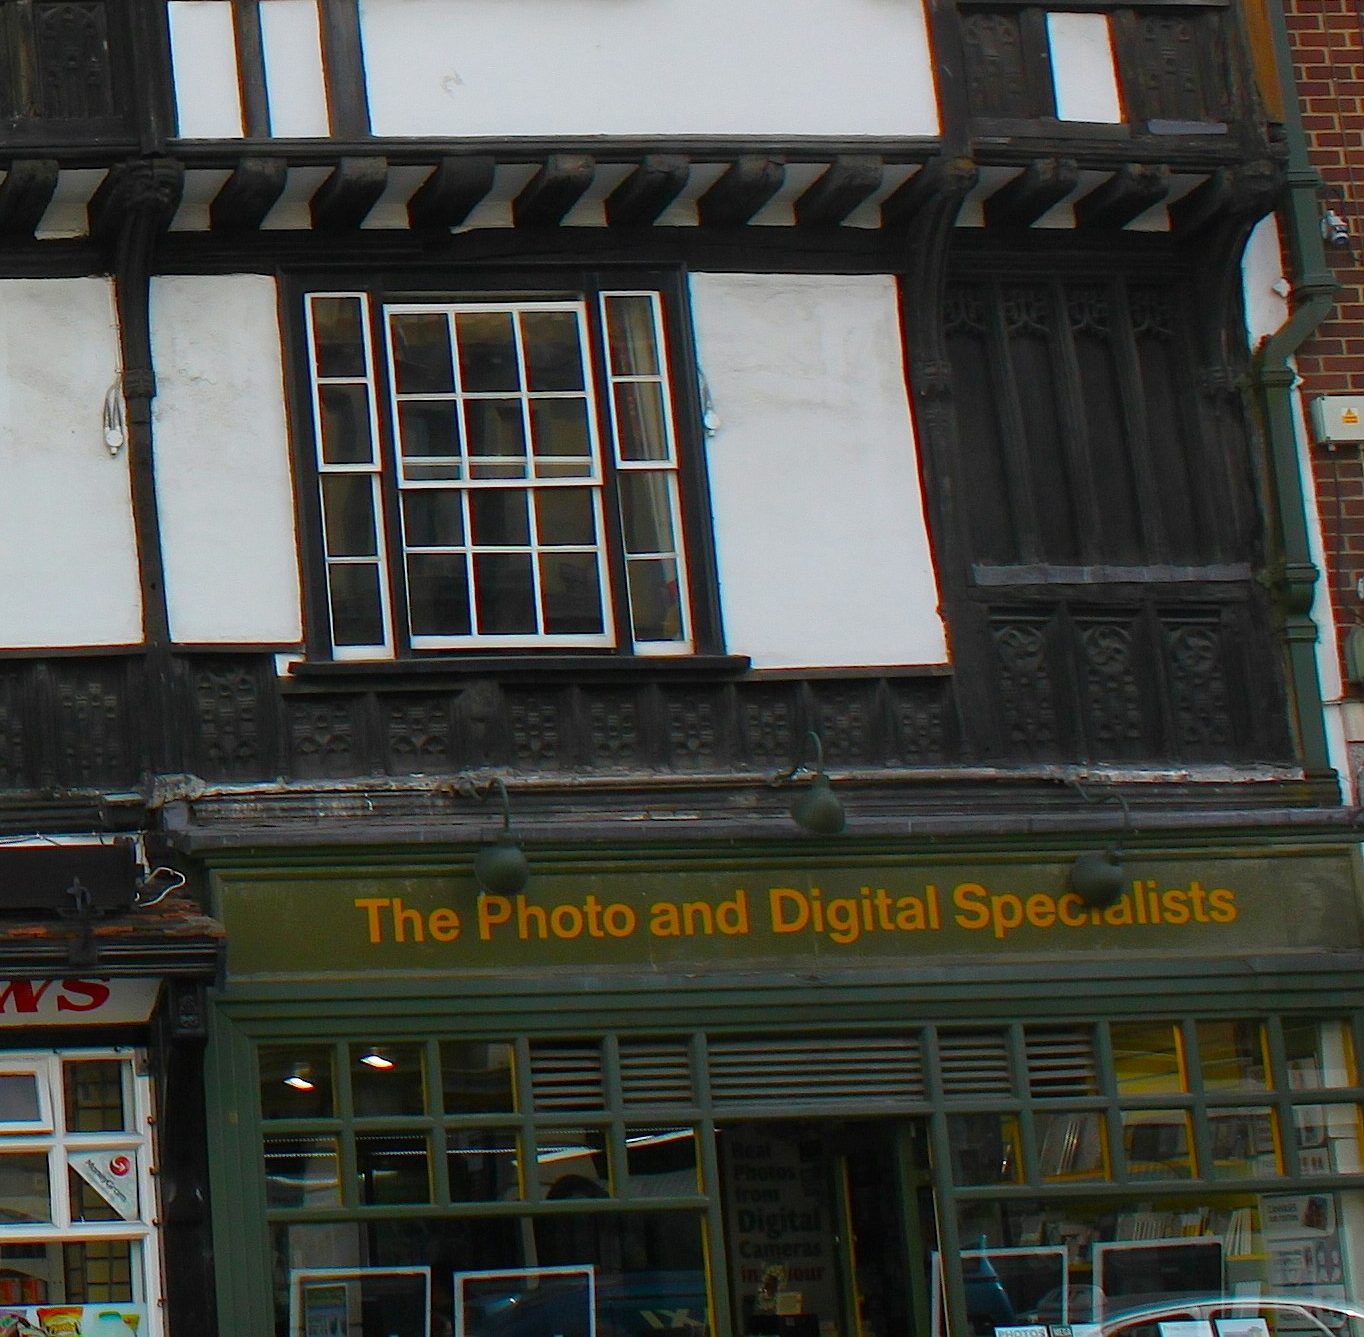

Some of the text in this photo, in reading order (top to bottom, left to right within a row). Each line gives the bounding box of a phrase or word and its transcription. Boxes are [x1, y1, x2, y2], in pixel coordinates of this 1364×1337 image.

[355, 898, 460, 943] The
[477, 893, 636, 941] Photo
[649, 889, 750, 935] and
[770, 885, 941, 945] Digital
[84, 1159, 127, 1203] MoneyGram
[739, 1207, 823, 1240] Digital
[740, 1241, 823, 1259] Cameras
